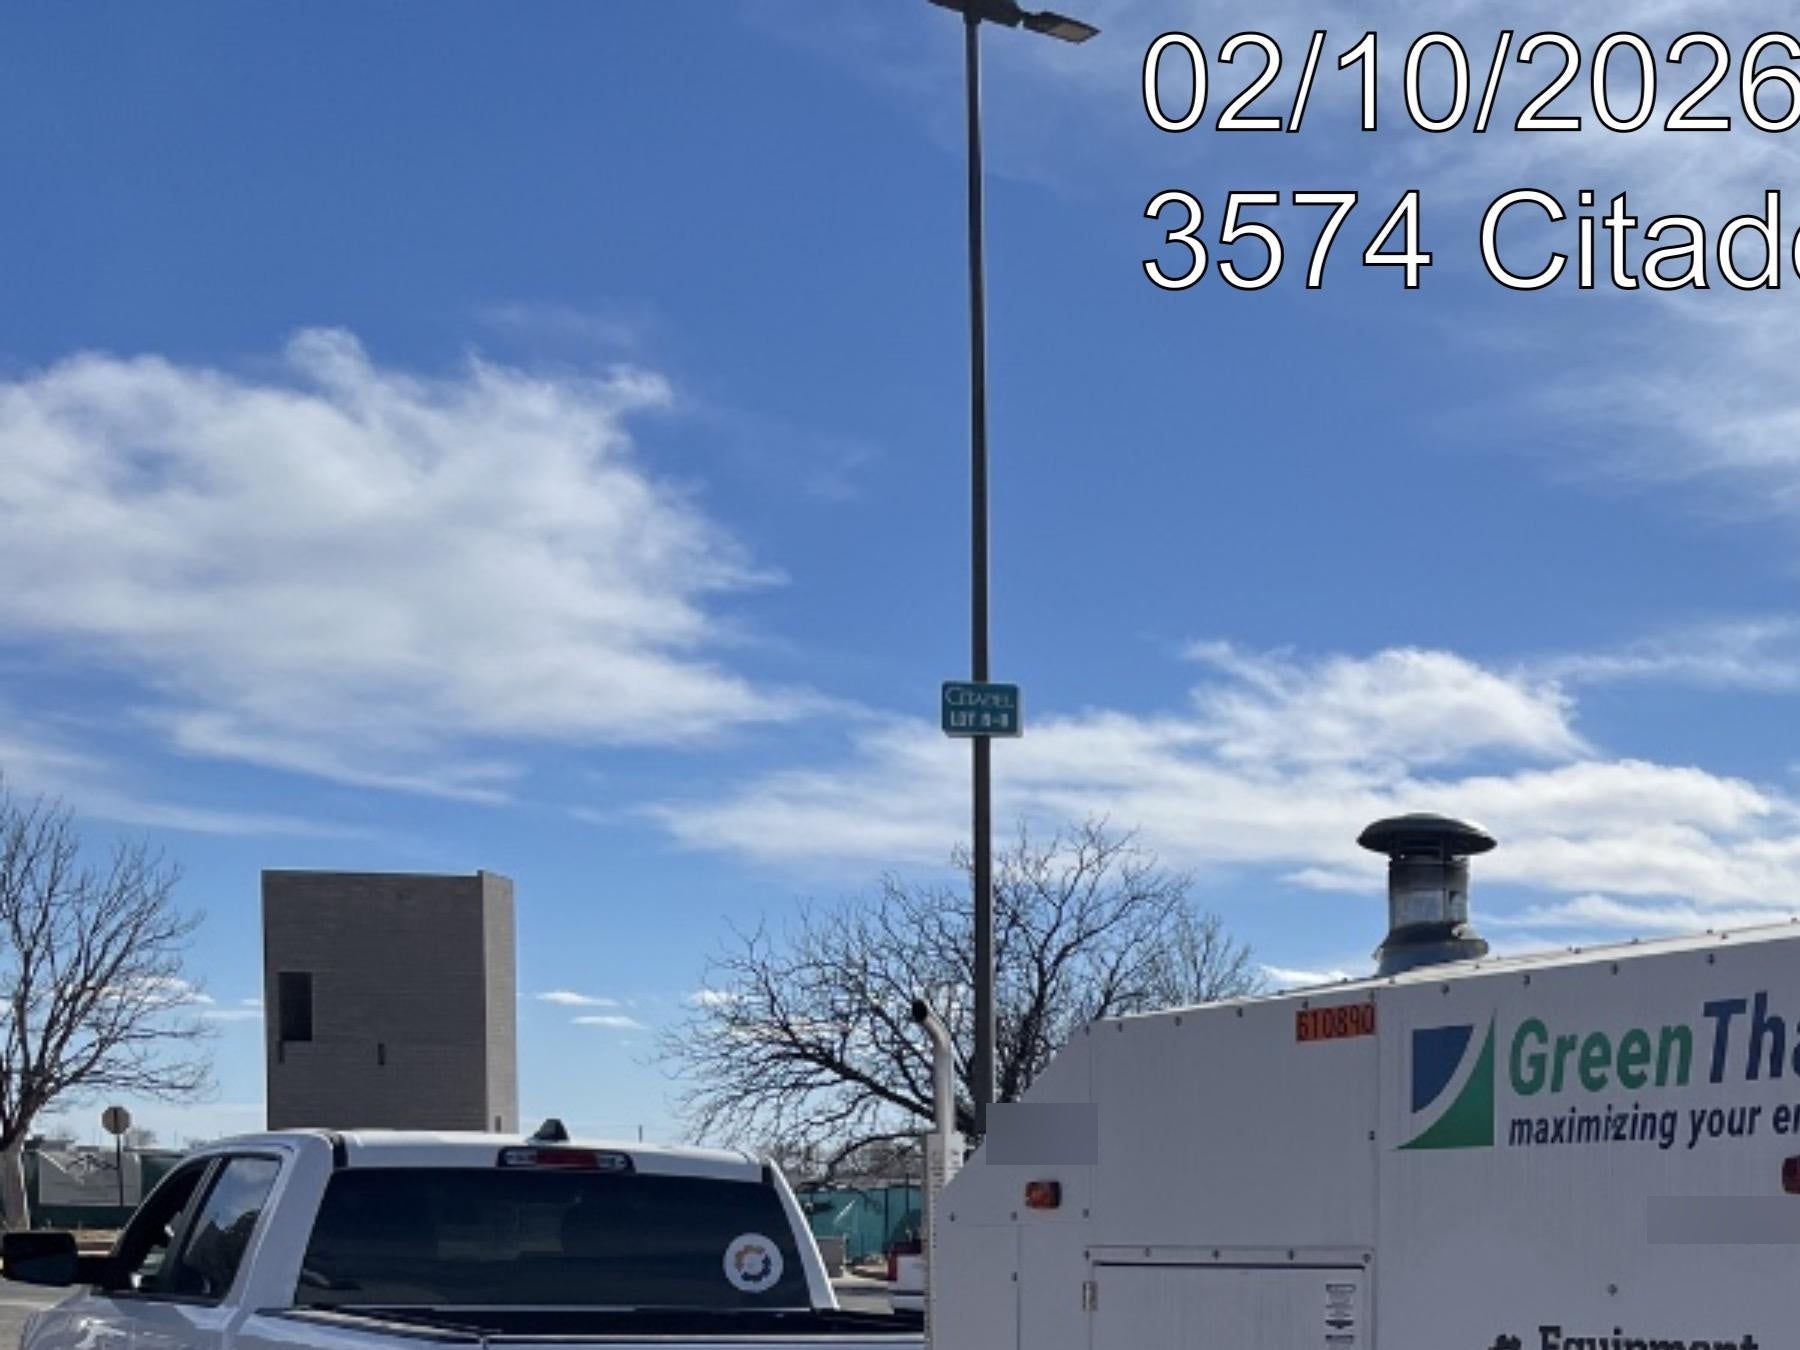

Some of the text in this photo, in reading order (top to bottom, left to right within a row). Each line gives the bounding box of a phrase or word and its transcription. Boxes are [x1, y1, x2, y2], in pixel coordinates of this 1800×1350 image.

[1297, 1003, 1376, 1041] 610890
[1508, 1102, 1677, 1150] maximizing
[1686, 1106, 1762, 1150] your
